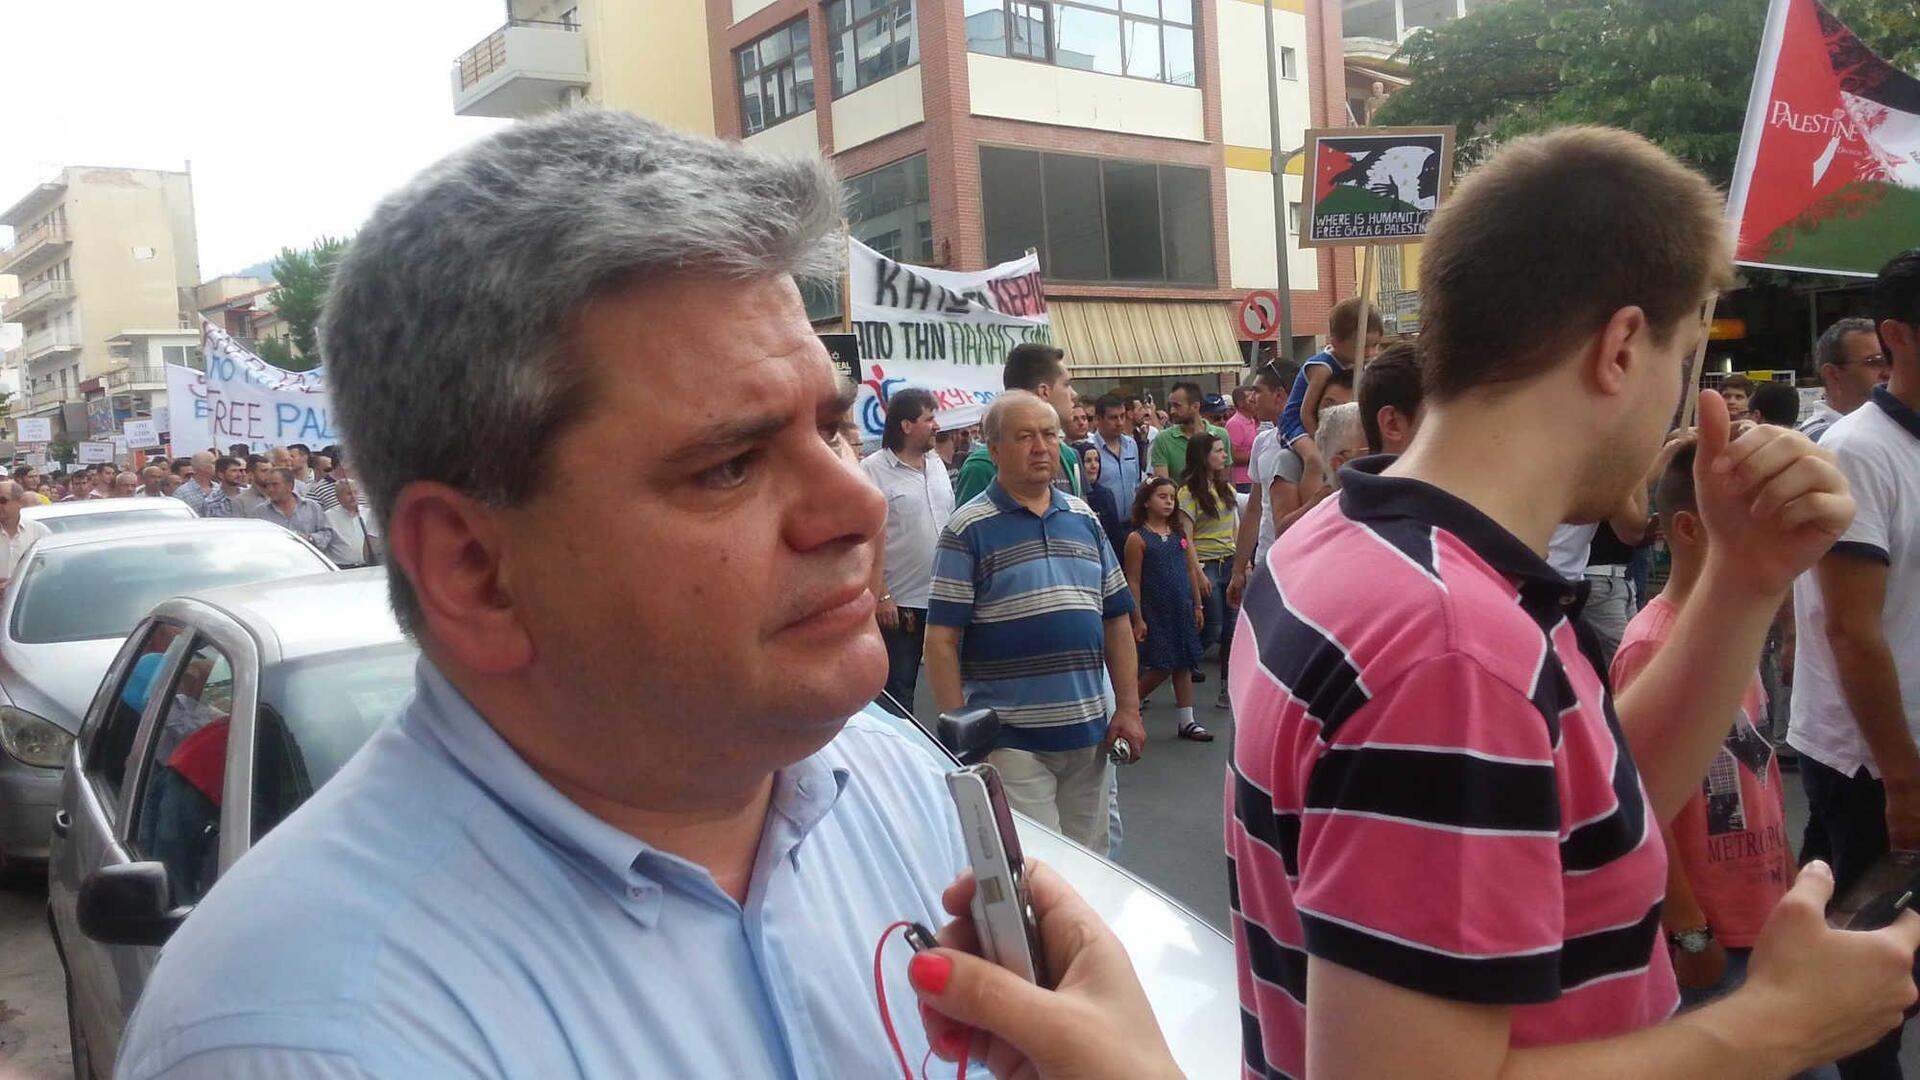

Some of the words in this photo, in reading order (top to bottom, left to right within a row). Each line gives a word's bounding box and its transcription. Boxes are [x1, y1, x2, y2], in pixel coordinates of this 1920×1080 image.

[1771, 101, 1858, 141] PALESTINE
[1316, 213, 1350, 227] WHERE
[1354, 213, 1365, 225] IS
[1316, 226, 1342, 238] FREE
[1344, 225, 1372, 237] GAZA
[898, 321, 946, 360] ΤΗΝ
